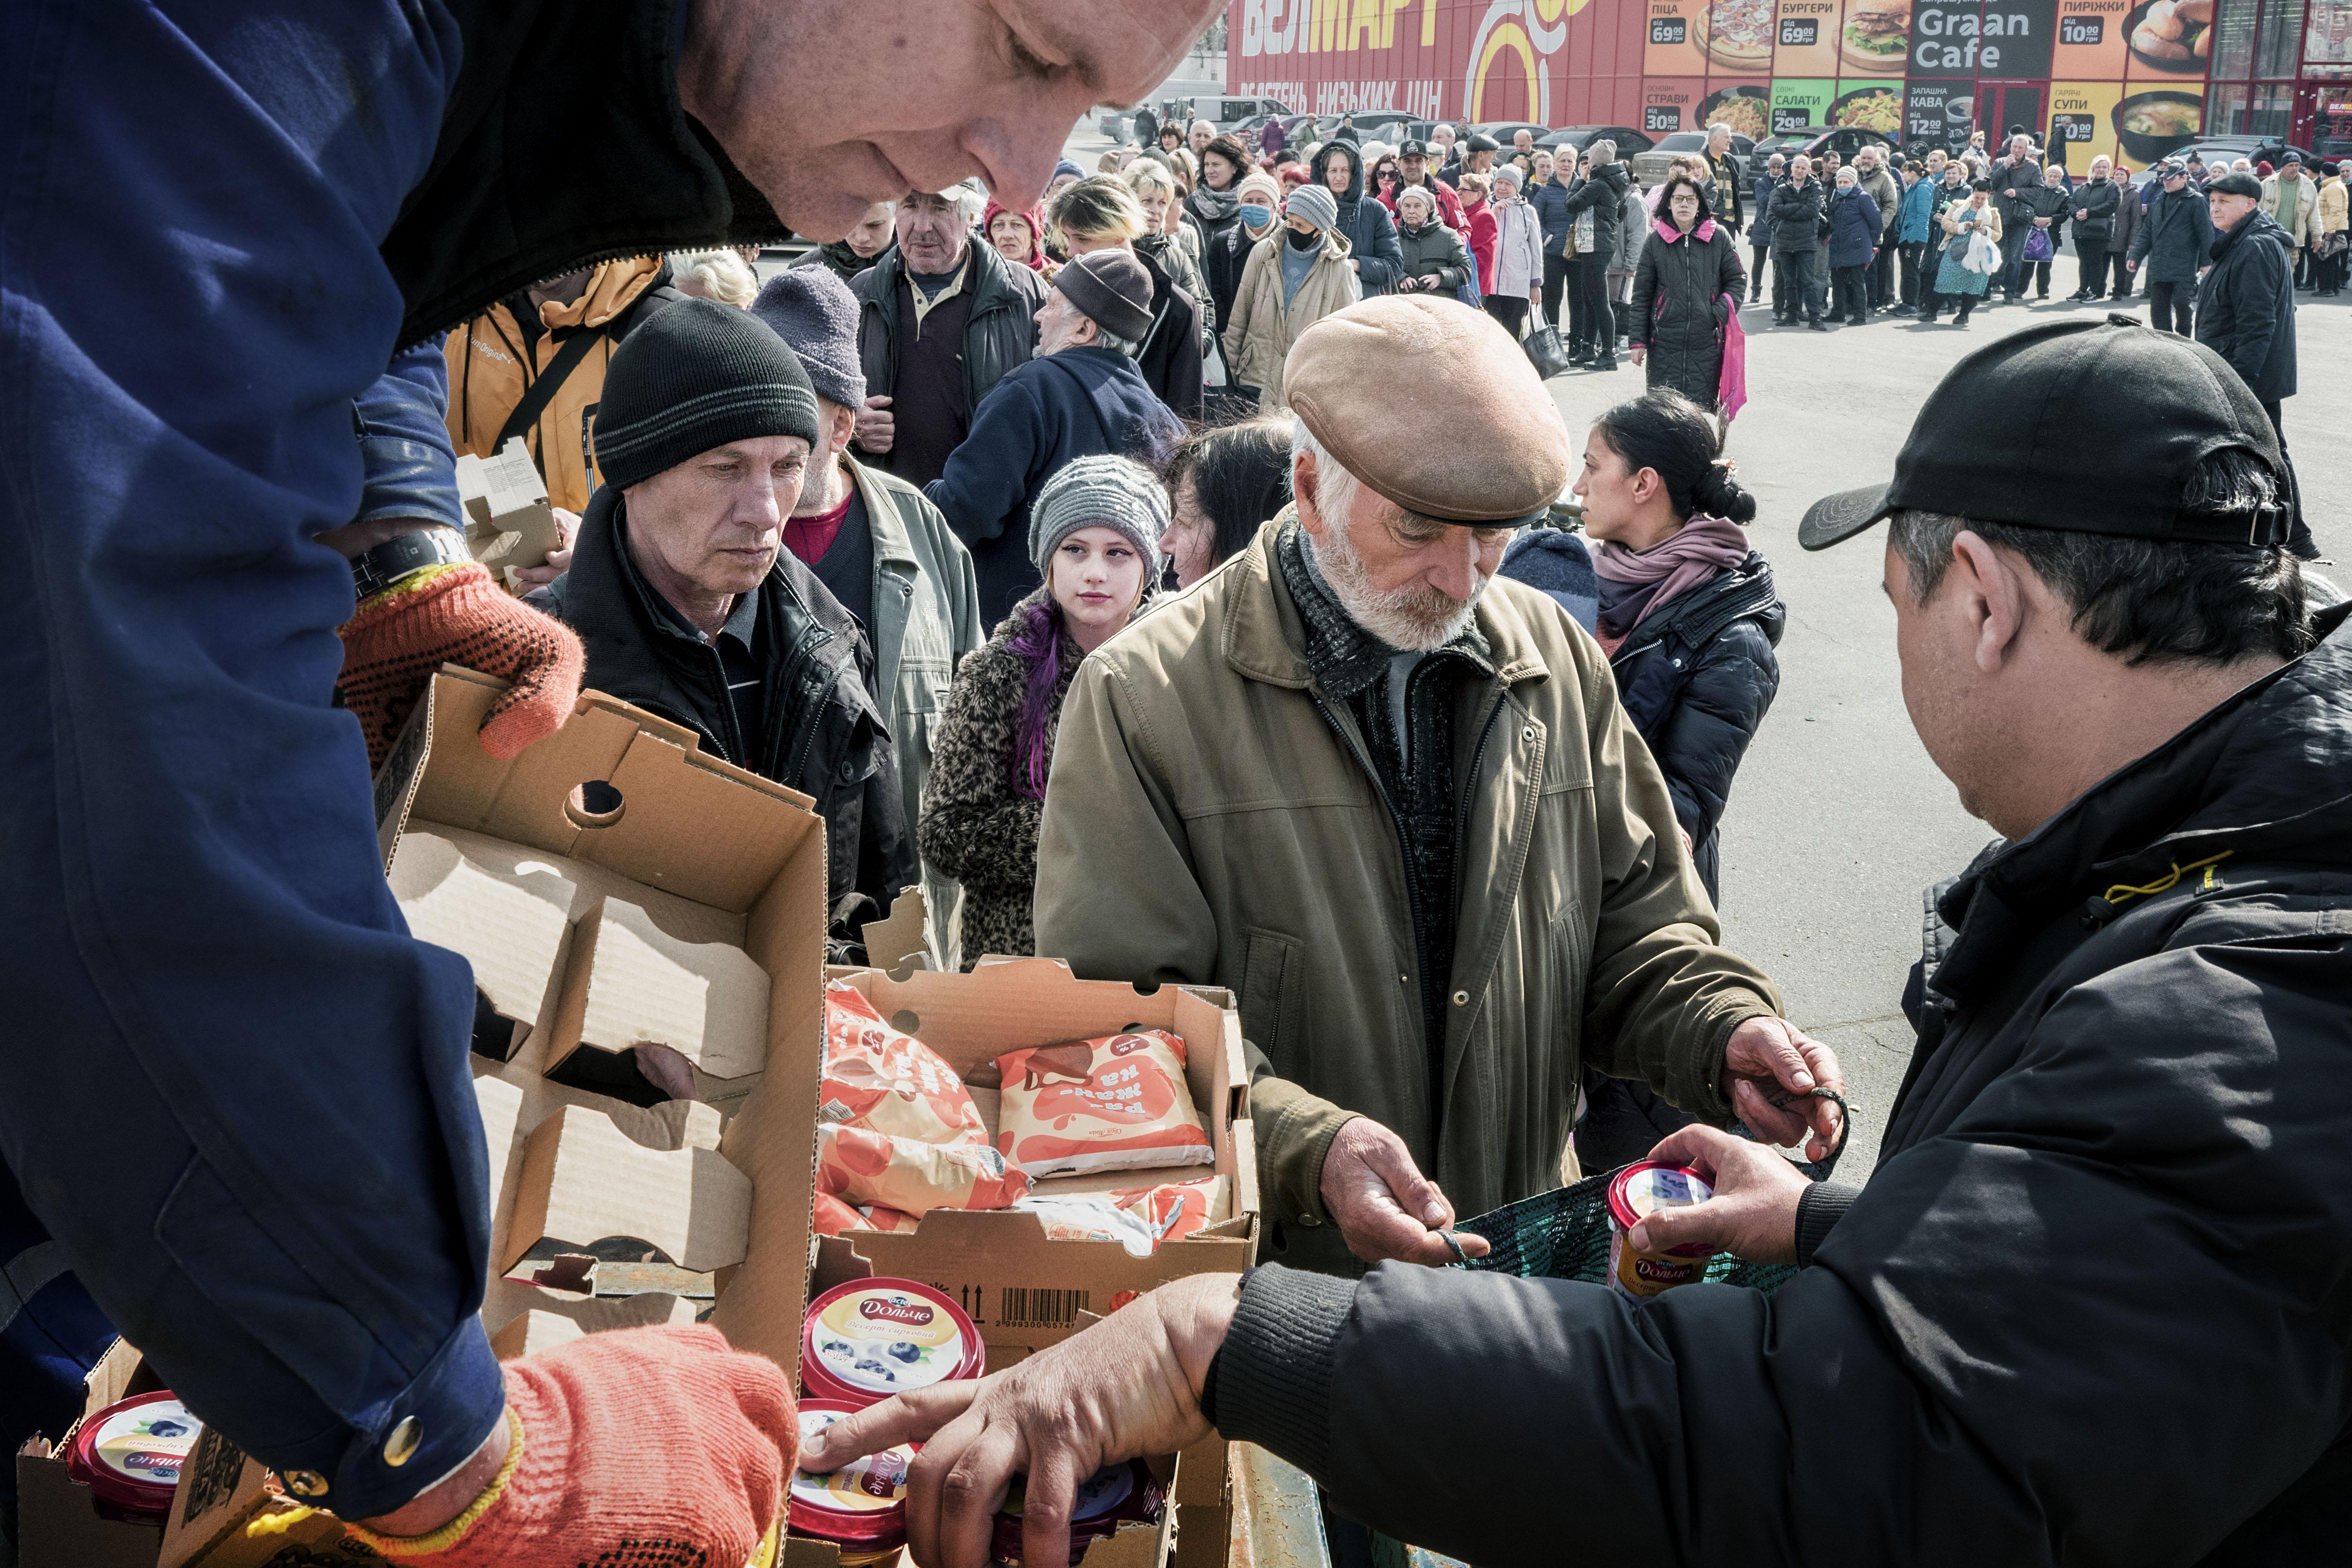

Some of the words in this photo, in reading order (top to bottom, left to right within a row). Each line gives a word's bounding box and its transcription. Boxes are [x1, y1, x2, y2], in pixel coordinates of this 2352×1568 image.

[1652, 4, 1678, 15] ПІЦА
[1782, 3, 1833, 13] БУРГЕРИ
[2064, 1, 2124, 12] ПИРІЖКИ
[1918, 9, 2029, 36] Graan
[1653, 27, 1673, 42] 69
[1782, 28, 1803, 43] 69
[2063, 26, 2086, 42] 10
[2087, 26, 2099, 34] 00
[1916, 37, 2000, 68] Cafe
[1316, 81, 1397, 115] НИЗЬКИХ
[1647, 94, 1689, 104] СТРАВИ
[1775, 95, 1821, 105] САЛАТИ
[1910, 97, 1943, 107] КАВА
[2054, 99, 2088, 109] СУПИ
[1646, 115, 1667, 129] 30
[1774, 117, 1795, 131] 29
[1910, 120, 1929, 135] 12
[1637, 1260, 1690, 1279] Дольче
[887, 1295, 913, 1307] lactel
[863, 1301, 930, 1321] Дольче
[845, 1321, 885, 1333] Десерт
[888, 1328, 935, 1339] сирковий
[869, 1452, 902, 1495] Дольче
